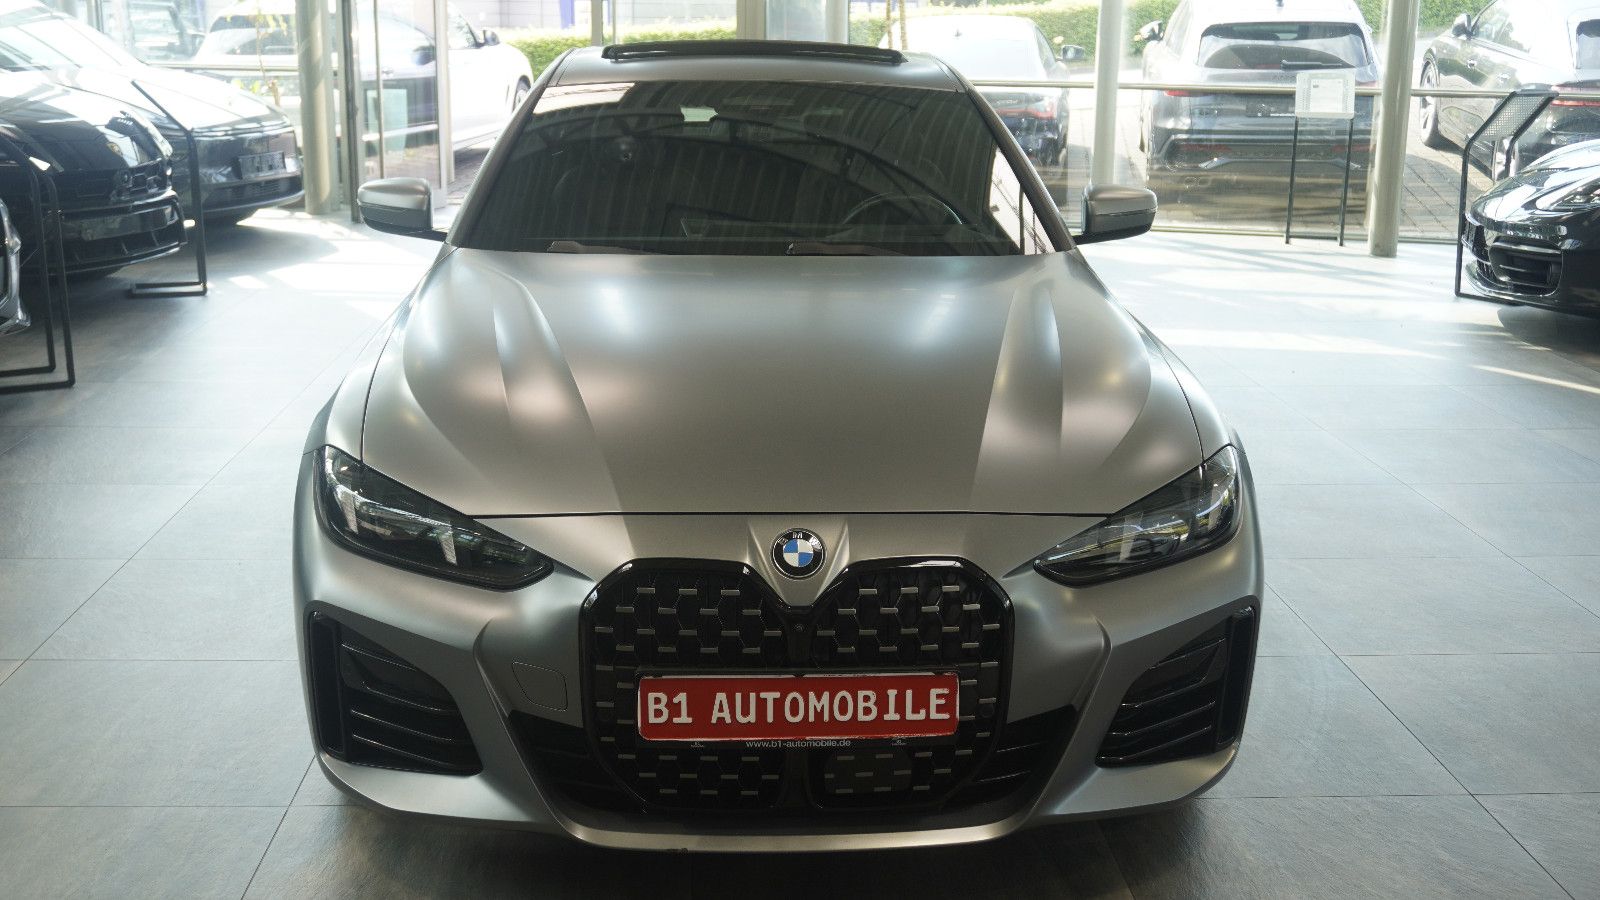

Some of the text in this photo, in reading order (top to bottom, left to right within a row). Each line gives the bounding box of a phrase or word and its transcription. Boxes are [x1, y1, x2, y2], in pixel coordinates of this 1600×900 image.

[647, 688, 950, 724] B1 AUTOMOBILE
[746, 739, 851, 749] www.b1-automobile.de
